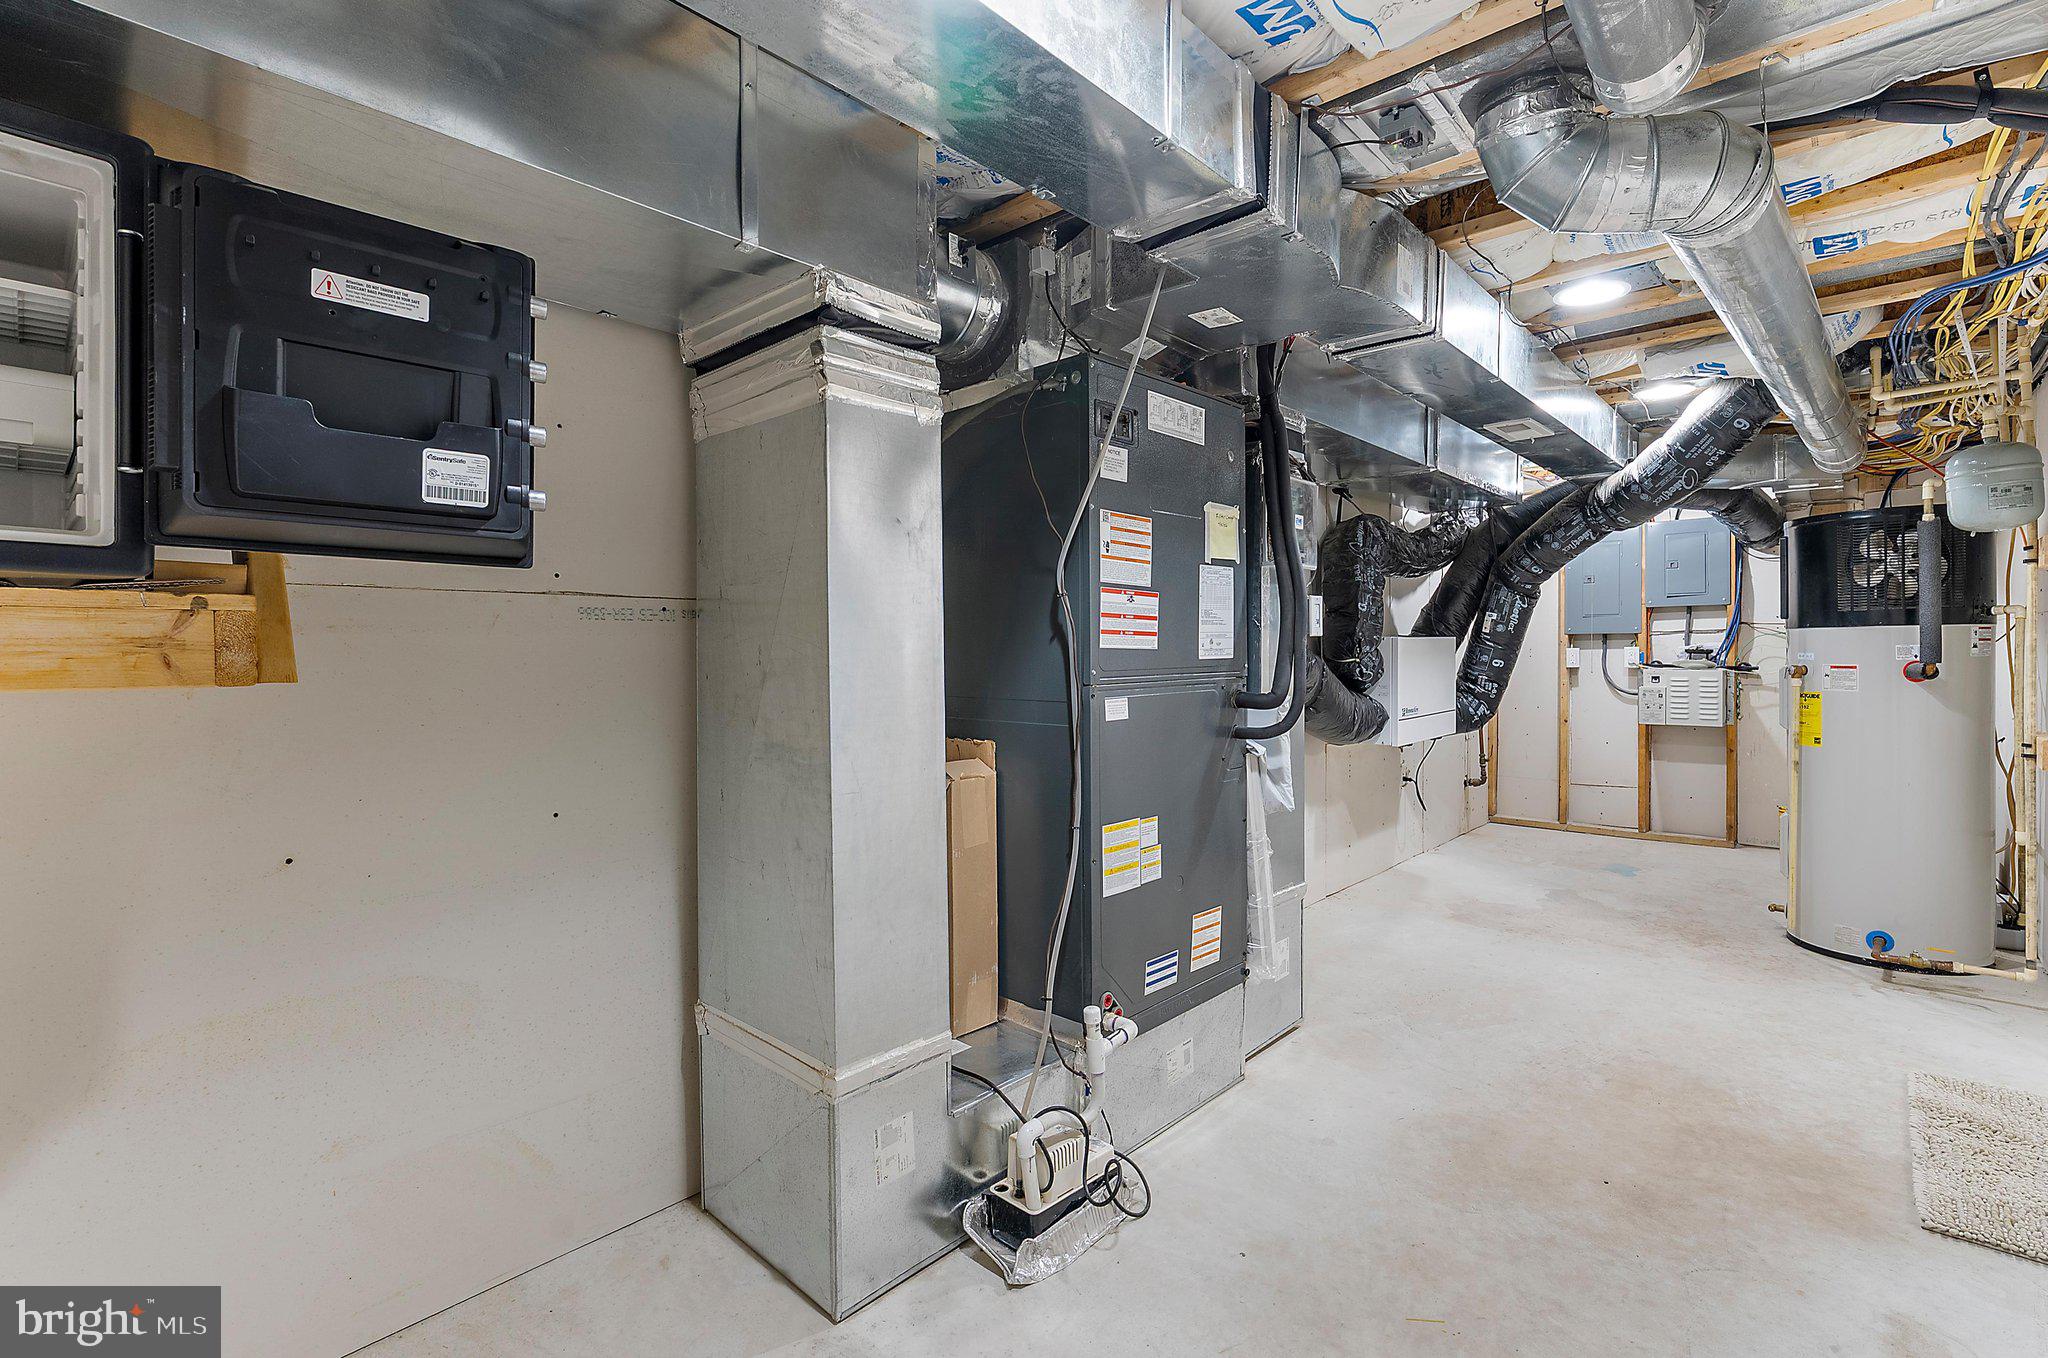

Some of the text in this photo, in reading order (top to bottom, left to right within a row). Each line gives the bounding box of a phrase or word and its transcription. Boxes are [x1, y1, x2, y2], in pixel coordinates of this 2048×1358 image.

[1733, 418, 1750, 431] 6
[431, 455, 467, 465] SentrySafe
[1652, 467, 1699, 507] Quietflex
[1531, 564, 1544, 575] 6
[1491, 658, 1505, 668] 6
